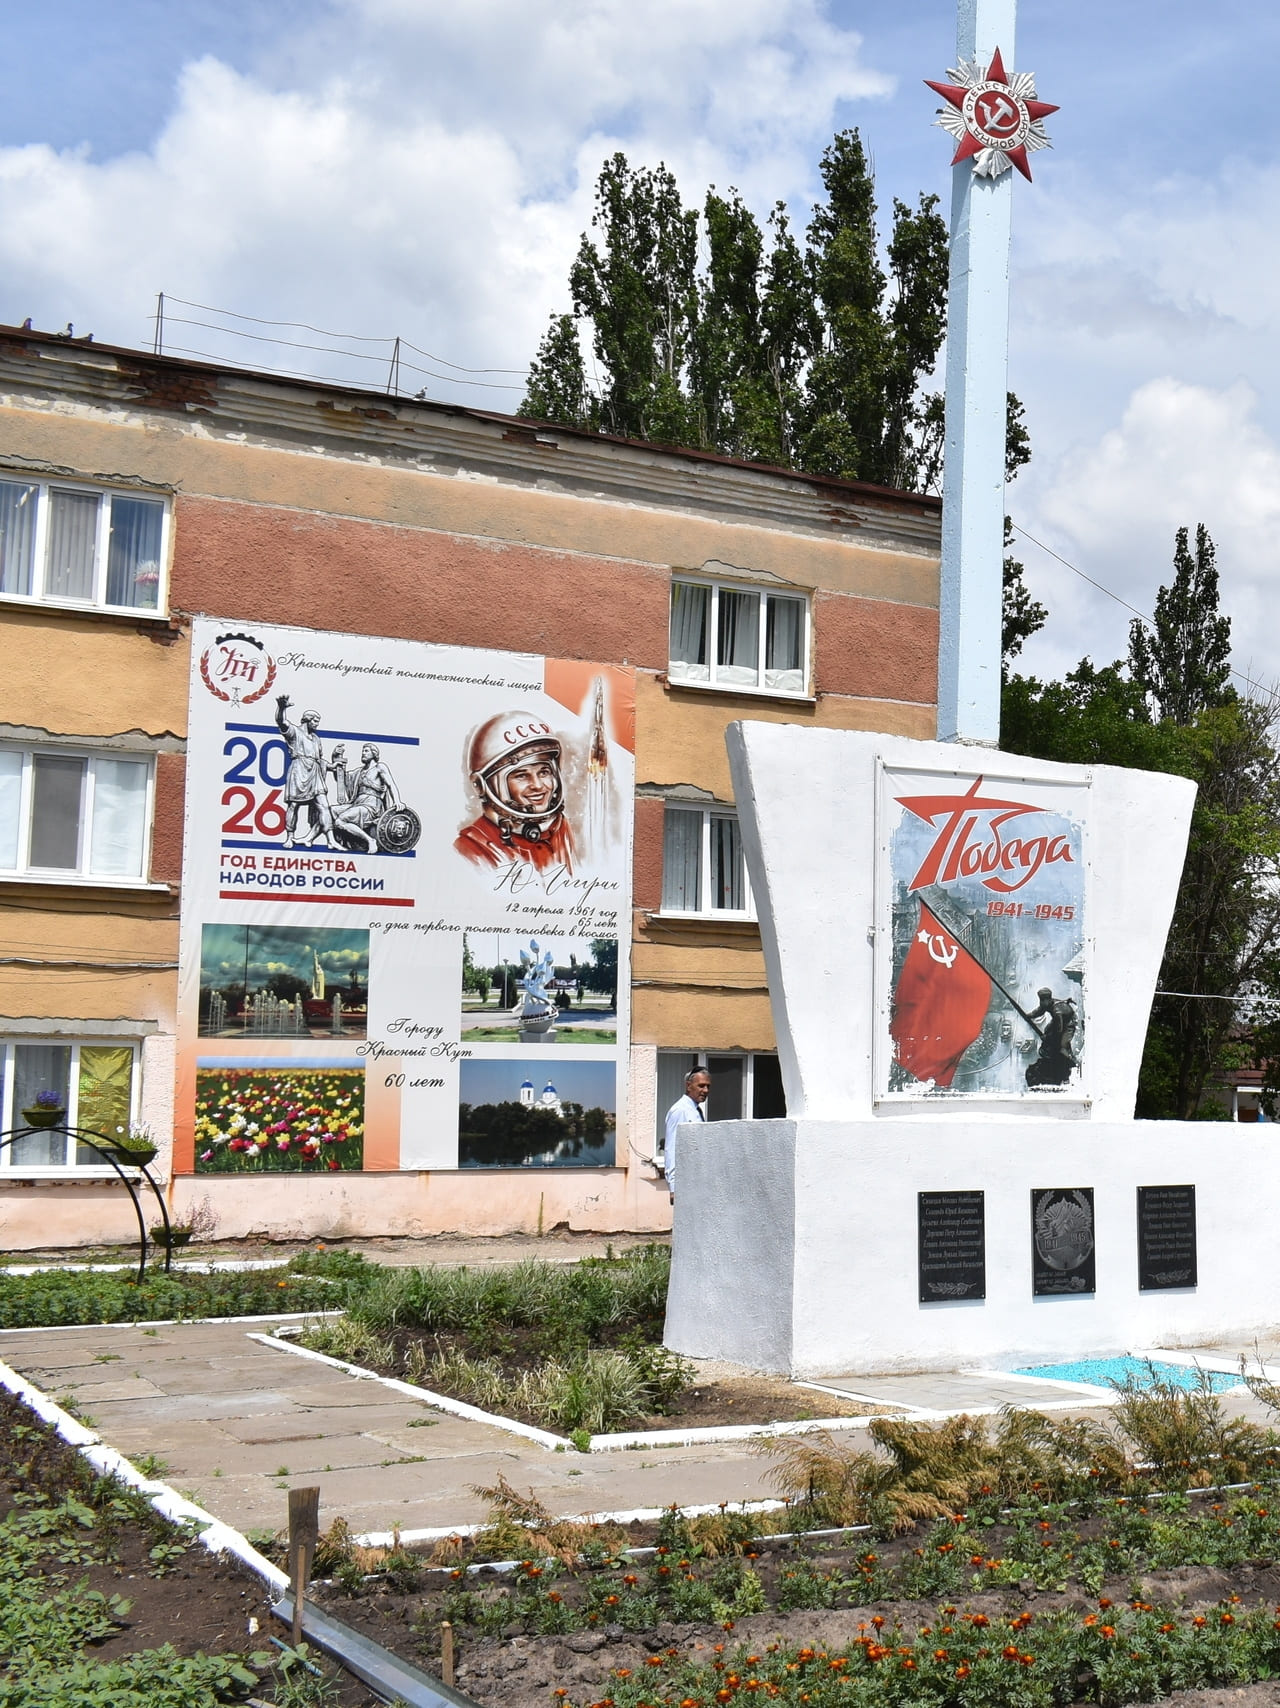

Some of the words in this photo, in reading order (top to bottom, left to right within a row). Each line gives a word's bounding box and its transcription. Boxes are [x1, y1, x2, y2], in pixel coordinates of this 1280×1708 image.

[966, 82, 1028, 140] ОТЕЧЕСТВЕННАЯ
[277, 652, 393, 677] Краснокутский
[396, 670, 505, 688] политехнический
[507, 682, 542, 692] лицей
[223, 736, 293, 787] 20
[221, 785, 287, 836] 26
[893, 774, 1075, 893] Победа
[220, 854, 257, 870] ГОД
[263, 856, 357, 873] ЕДИНСТВА
[219, 871, 306, 888] НАРОДОВ
[312, 875, 385, 891] РОССИИ
[505, 903, 520, 913] 12
[522, 906, 564, 918] апреля
[568, 906, 595, 917] 1961
[599, 912, 618, 922] год
[578, 917, 592, 927] 65
[594, 920, 618, 928] лет
[369, 921, 381, 929] со
[383, 921, 409, 934] дня
[413, 919, 461, 935] первого
[464, 925, 511, 934] полета
[515, 923, 566, 937] человека
[568, 925, 577, 937] в
[578, 926, 618, 939] космос
[387, 1018, 444, 1039] Городу
[356, 1041, 426, 1061] Красный
[430, 1041, 473, 1062] Кут
[384, 1073, 406, 1088] 60
[409, 1079, 445, 1088] лет
